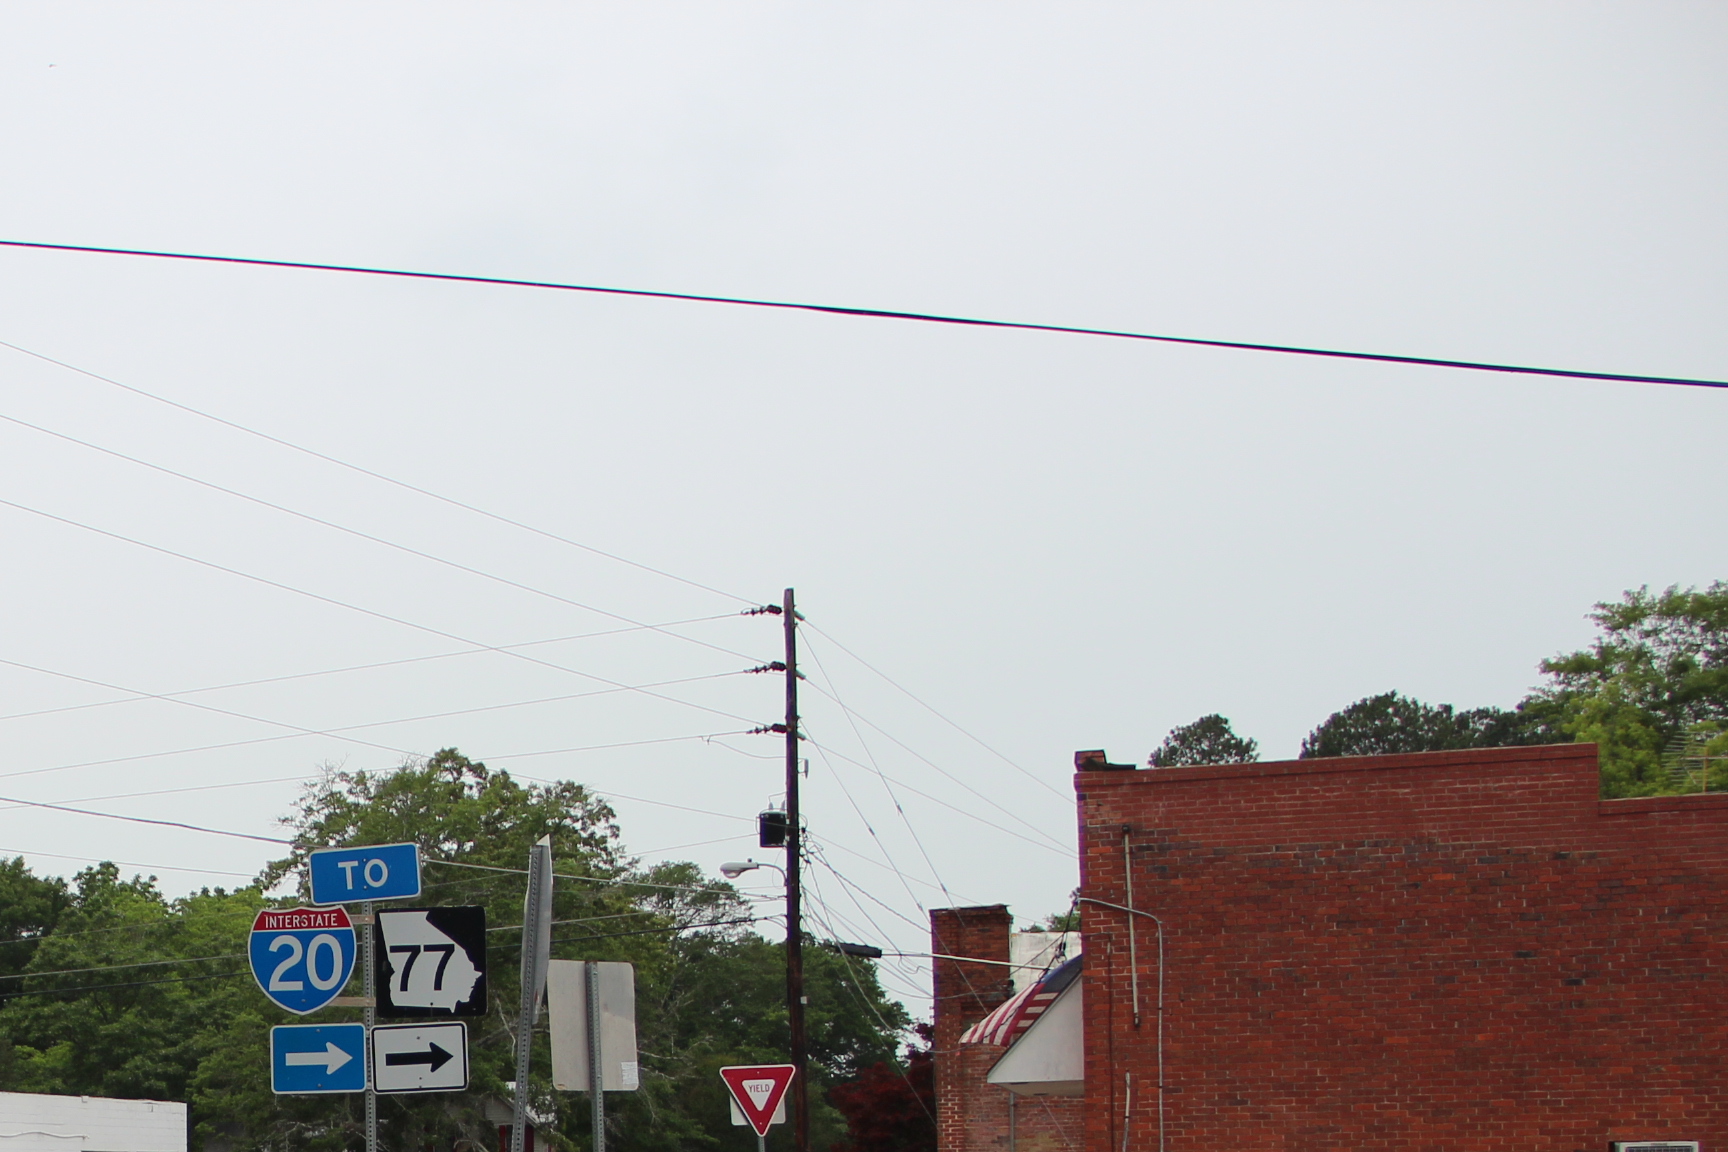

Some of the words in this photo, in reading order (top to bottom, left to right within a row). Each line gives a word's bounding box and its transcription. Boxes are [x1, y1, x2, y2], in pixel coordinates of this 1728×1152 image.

[337, 858, 389, 890] TO
[265, 913, 338, 929] INTERSTATE
[268, 933, 343, 992] 20
[389, 943, 455, 992] 77
[747, 1083, 770, 1093] YIELD
